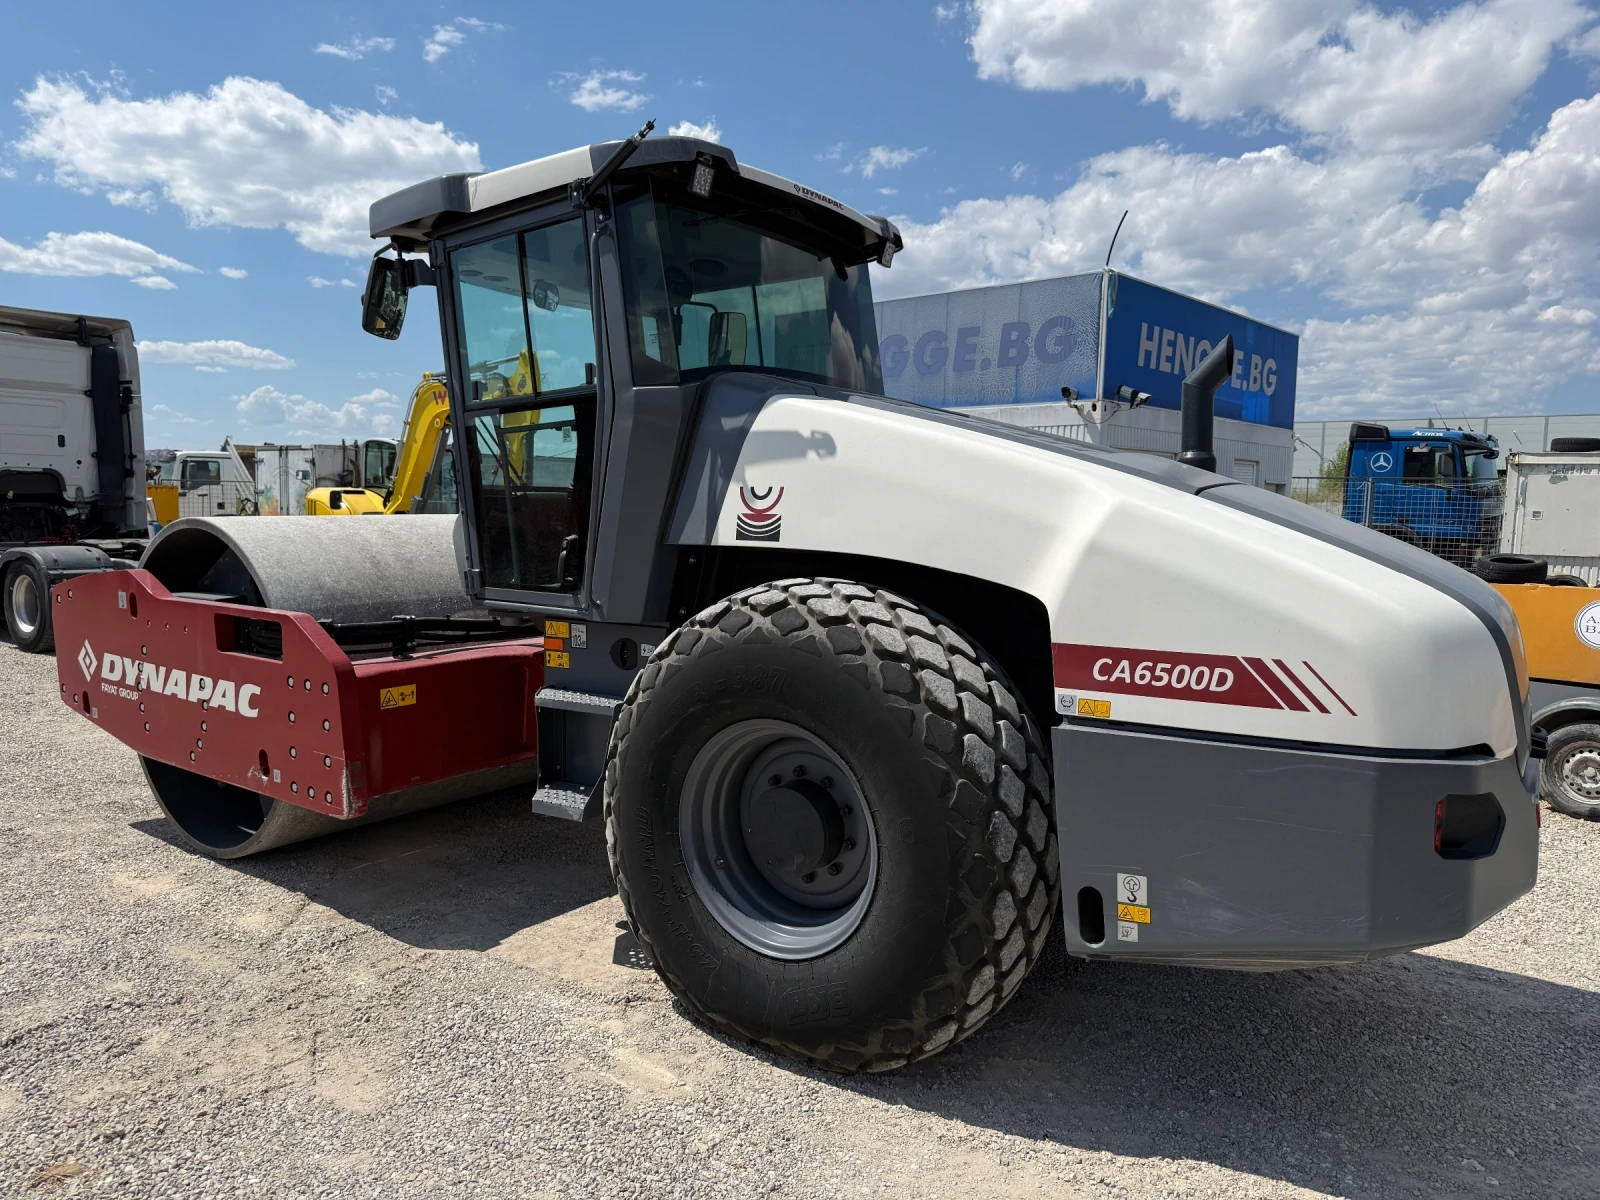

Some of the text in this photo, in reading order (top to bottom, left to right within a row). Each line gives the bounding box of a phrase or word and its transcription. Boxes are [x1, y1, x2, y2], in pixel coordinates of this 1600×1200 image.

[802, 187, 844, 211] DYNAPAC
[1137, 322, 1277, 396] HENE.BG
[1586, 616, 1600, 624] A.
[1586, 625, 1600, 634] B
[101, 652, 261, 718] DYNAPAC
[1092, 657, 1234, 692] CA6500D
[101, 682, 139, 701] FAYAT GROUP
